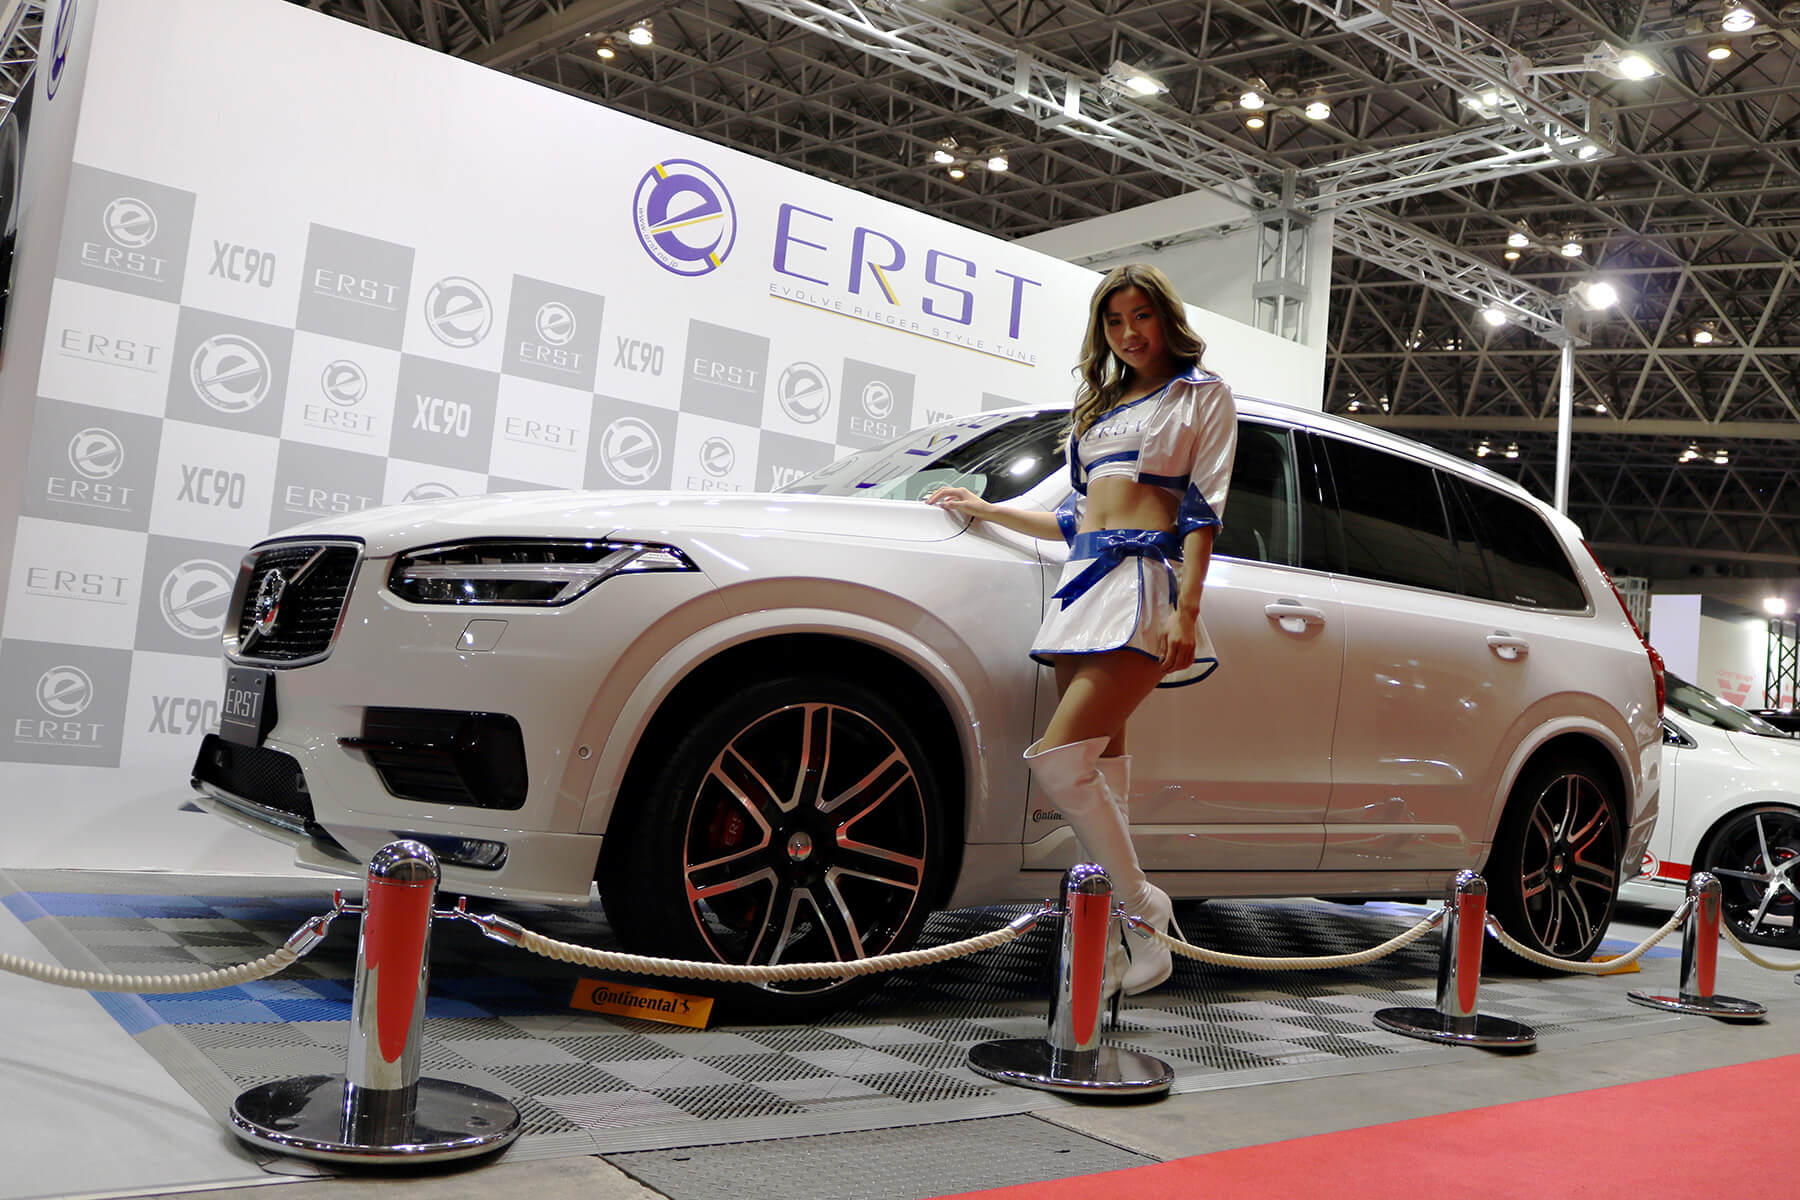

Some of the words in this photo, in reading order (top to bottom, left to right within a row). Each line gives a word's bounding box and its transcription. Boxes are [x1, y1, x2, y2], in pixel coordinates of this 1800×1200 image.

[81, 241, 168, 277] ERST
[208, 239, 277, 289] XC90
[773, 203, 1042, 340] ERST
[314, 268, 400, 305] ERST
[769, 283, 842, 310] EVOLVE
[854, 306, 921, 330] RIEGER
[932, 328, 985, 349] STYLE
[996, 345, 1037, 363] TUNE
[60, 328, 161, 367] ERST
[519, 341, 583, 369] ERST
[614, 335, 664, 377] XC90
[693, 358, 759, 388] ERST
[304, 404, 377, 433] ERST
[412, 394, 472, 438] XC90
[504, 416, 581, 448] ERST
[47, 476, 135, 506] ERST
[177, 464, 246, 509] XC90
[285, 485, 373, 513] ERST
[26, 567, 129, 599] ERST
[148, 695, 218, 735] XC90
[225, 688, 261, 718] ERST
[15, 719, 105, 742] ERST
[591, 987, 678, 1013] Continental
